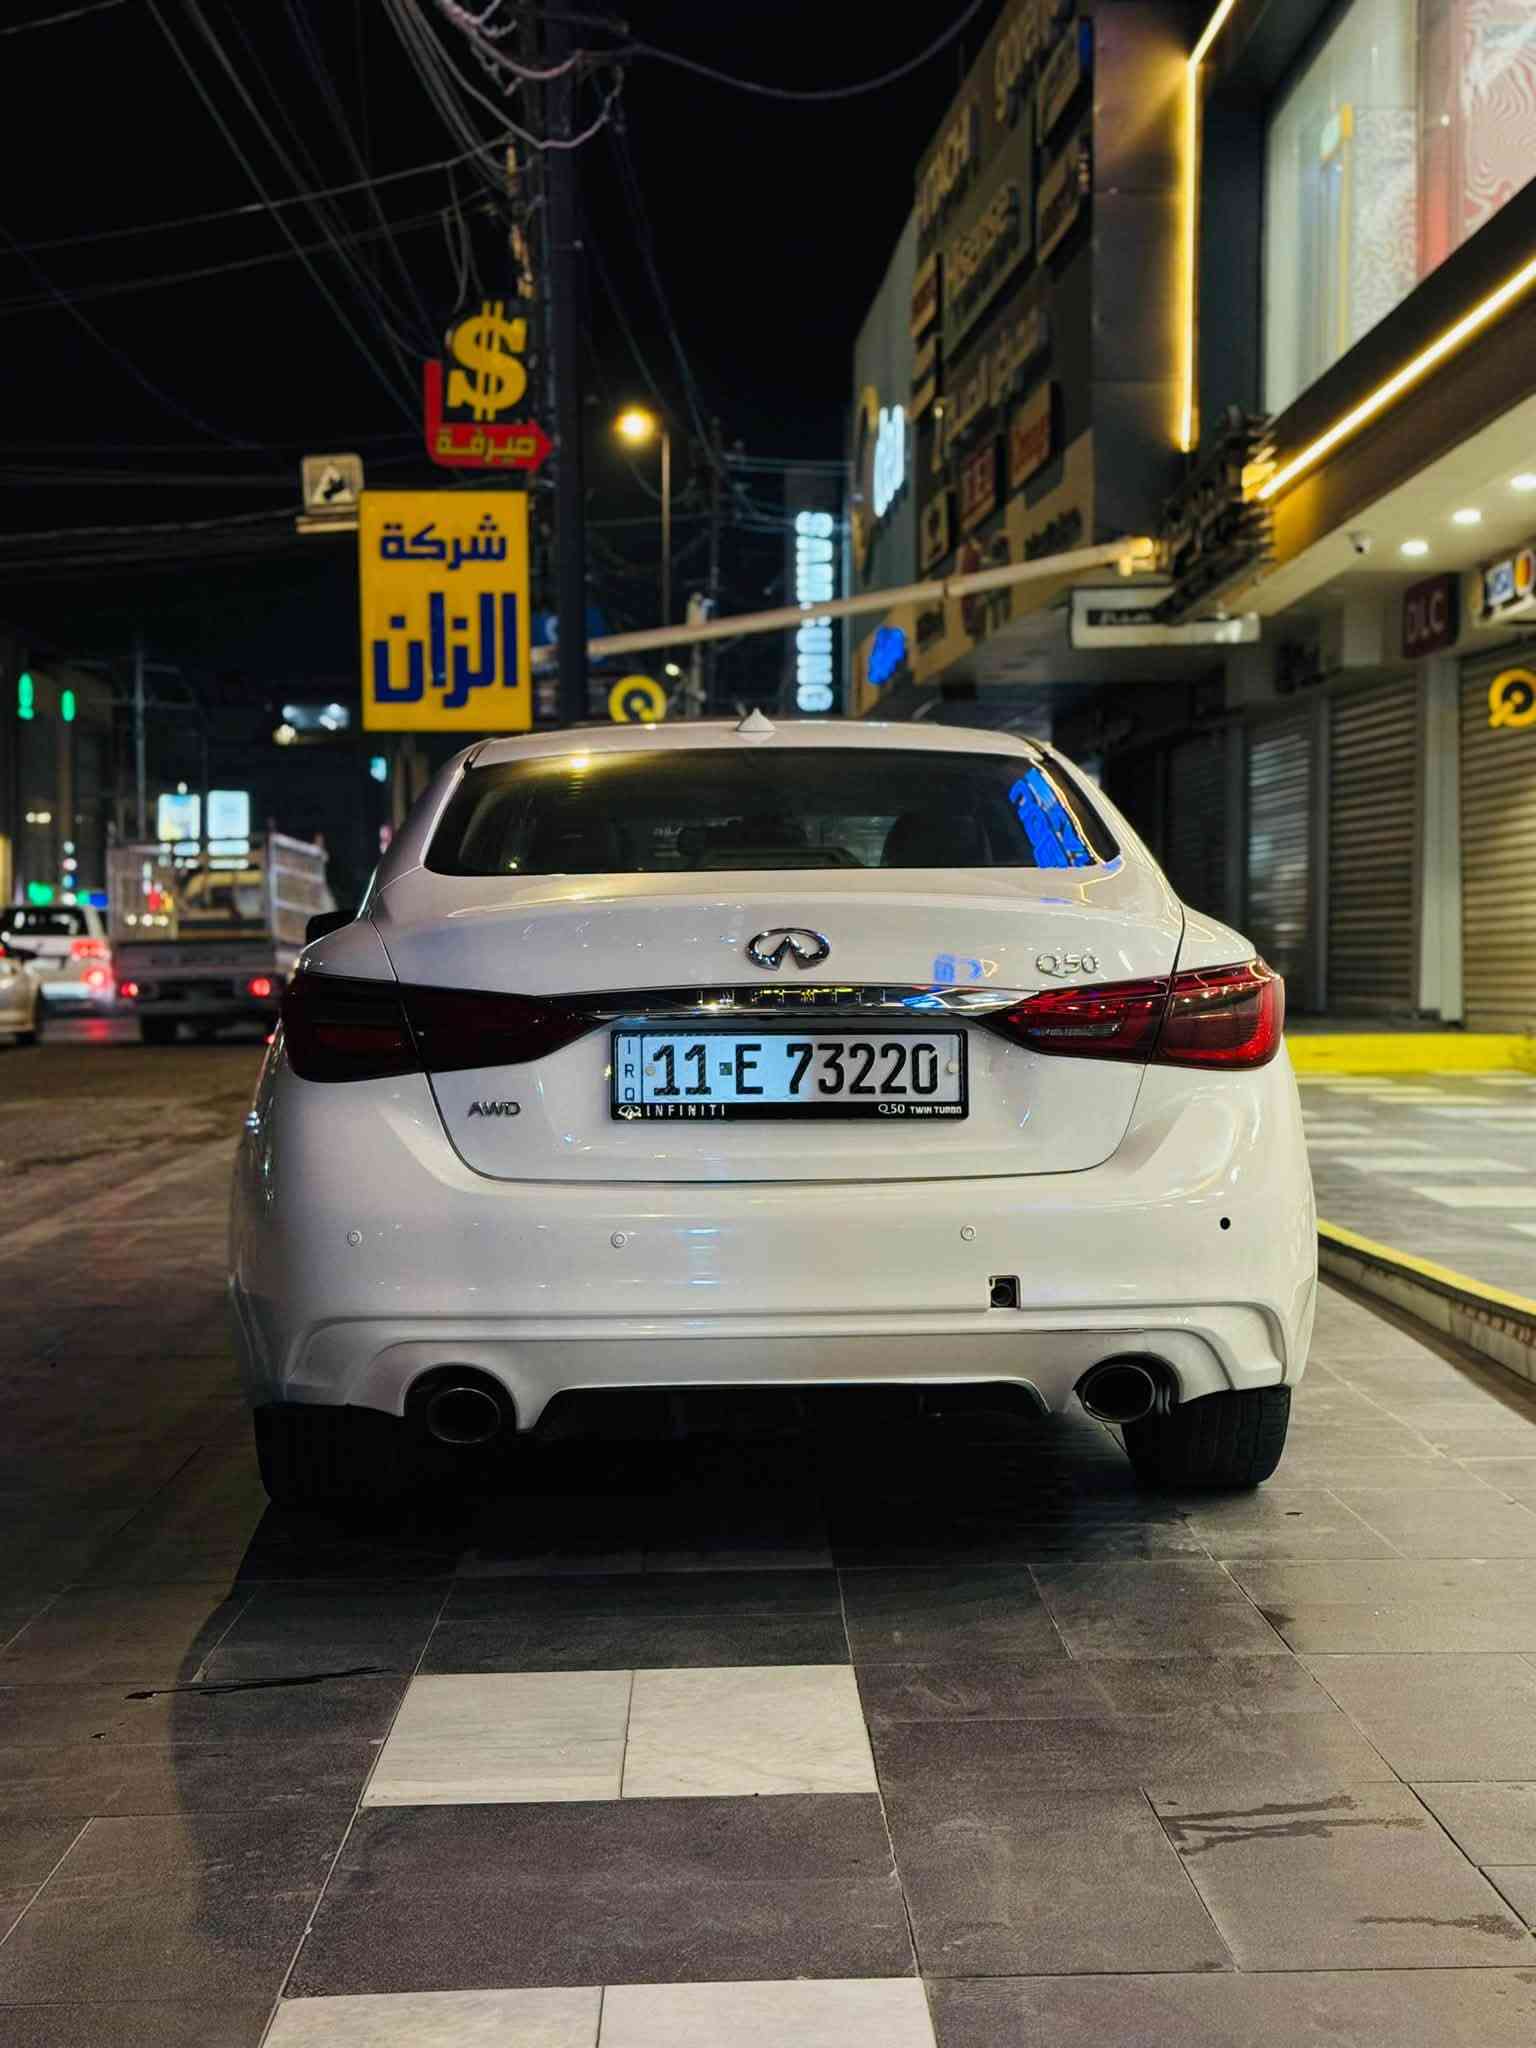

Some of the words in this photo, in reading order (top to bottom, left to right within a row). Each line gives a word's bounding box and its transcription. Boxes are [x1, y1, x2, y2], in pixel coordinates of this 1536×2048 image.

[435, 425, 537, 464] صيرفة
[380, 513, 507, 571] شركة
[795, 510, 833, 712] SAMUNG
[373, 591, 519, 708] الزان
[1035, 952, 1100, 979] Q50
[624, 1040, 635, 1101] IRQ
[652, 1043, 712, 1096] 11
[735, 1043, 764, 1095] E
[786, 1043, 938, 1095] 73220
[467, 1101, 521, 1117] AWD
[646, 1104, 726, 1116] INFINITI
[878, 1103, 905, 1115] Q50
[910, 1106, 932, 1114] TWIN
